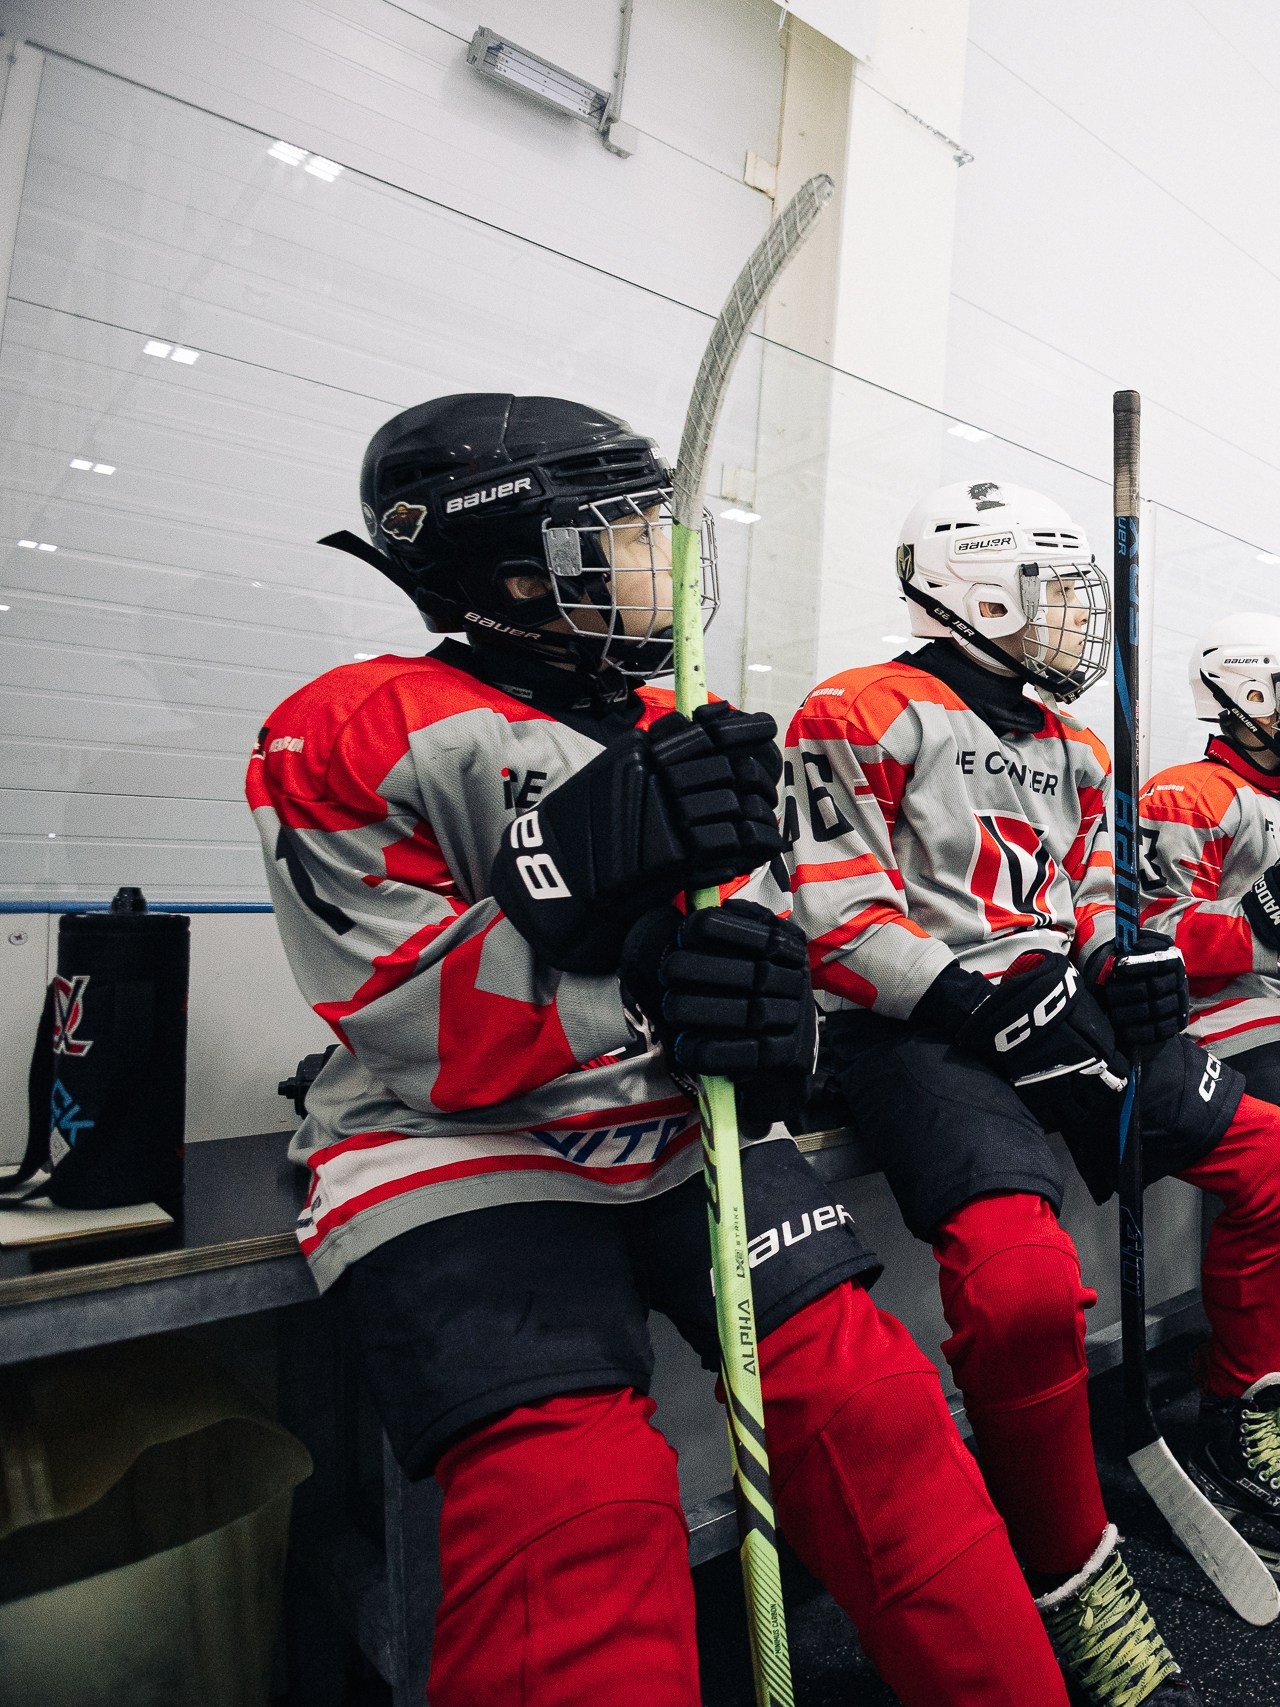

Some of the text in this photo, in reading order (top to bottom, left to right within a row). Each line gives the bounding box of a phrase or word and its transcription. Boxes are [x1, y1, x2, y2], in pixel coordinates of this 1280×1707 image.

[446, 477, 532, 514] BAUER
[958, 537, 1012, 552] BAUER
[464, 611, 542, 640] BAUER
[1223, 657, 1259, 665] BAUER
[1231, 707, 1258, 733] BAUER
[737, 1298, 757, 1377] ALPHA
[770, 1602, 780, 1628] CARBON
